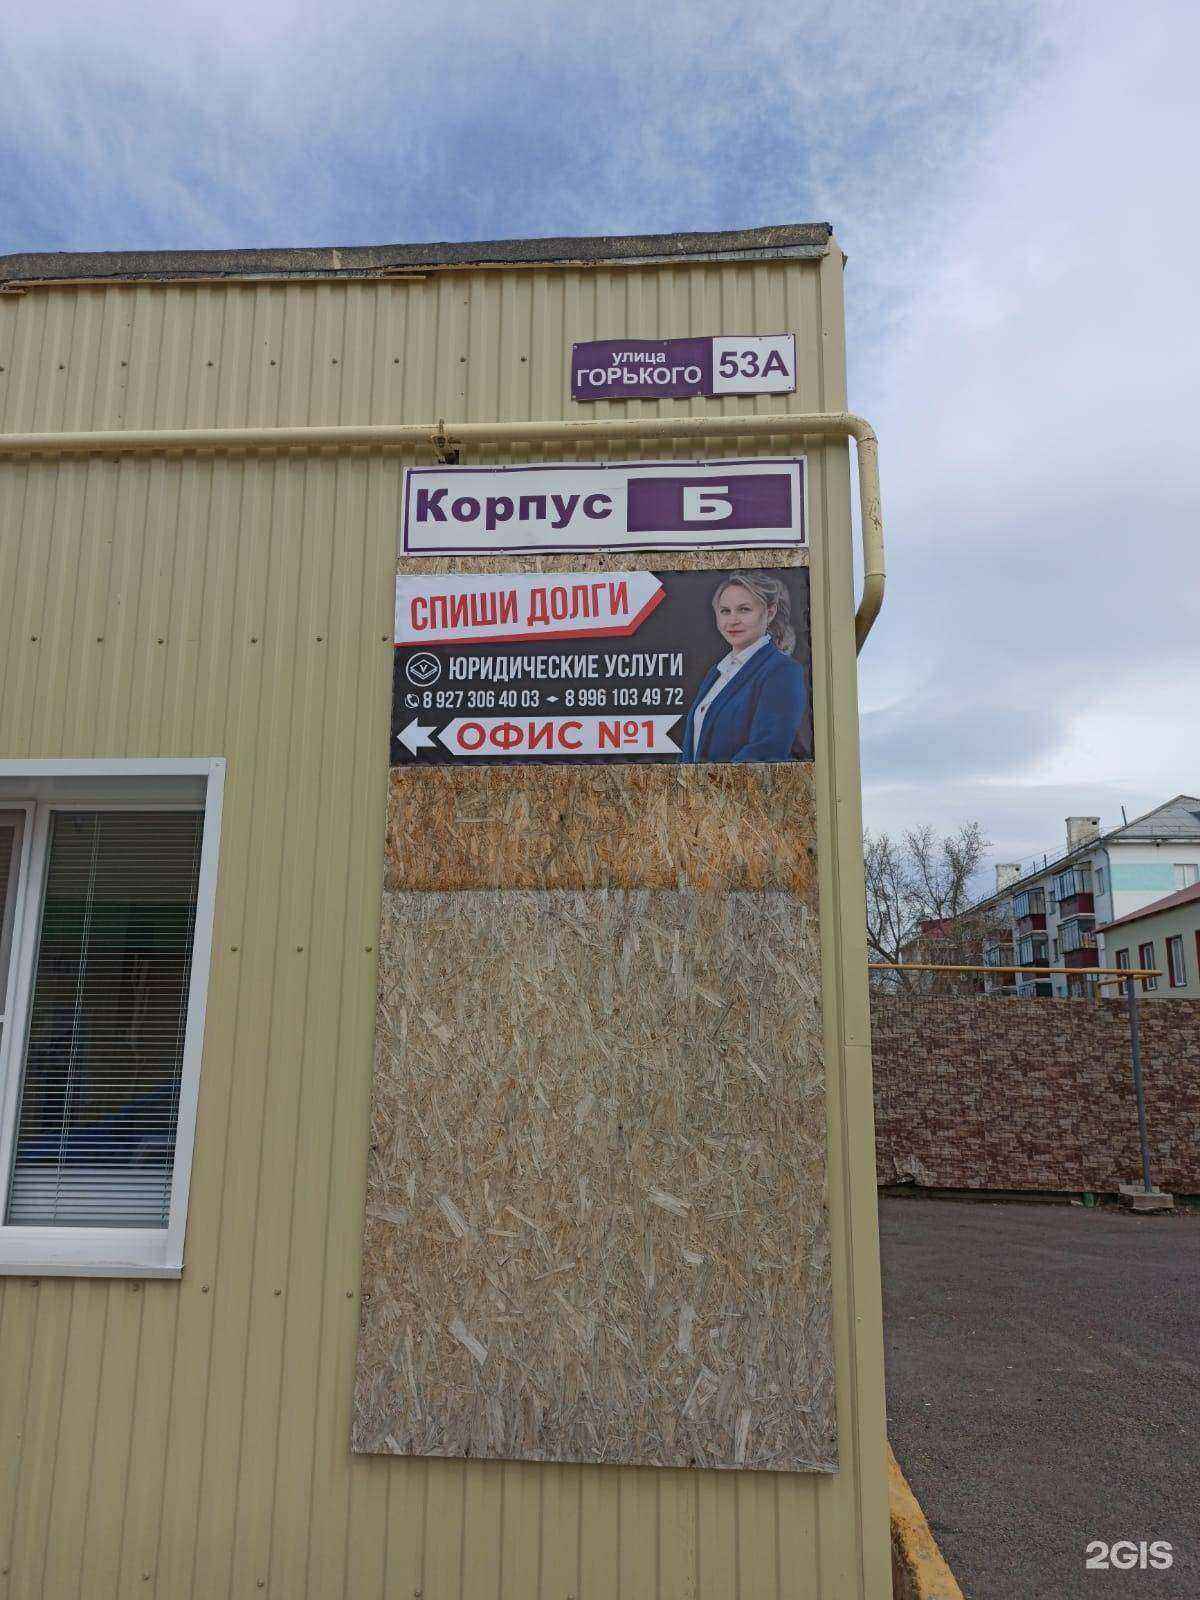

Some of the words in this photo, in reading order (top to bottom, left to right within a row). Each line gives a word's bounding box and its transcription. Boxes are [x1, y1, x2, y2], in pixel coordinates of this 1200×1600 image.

[612, 352, 666, 366] улица
[719, 350, 789, 379] 53А
[577, 366, 702, 387] ГОРЬКОГО
[416, 488, 613, 531] Корпус
[683, 485, 734, 522] Б
[410, 590, 518, 631] СПИШИ
[526, 581, 629, 627] ДОЛГИ
[448, 655, 599, 682] ЮРИДИЧЕСКИЕ
[604, 653, 683, 678] УСЛУГИ
[423, 691, 433, 709] 8
[436, 690, 464, 708] 927
[467, 690, 495, 708] 306
[498, 690, 517, 708] 40
[521, 689, 540, 708] 03
[565, 689, 575, 707] 8
[578, 688, 606, 707] 996
[612, 688, 638, 706] 103
[641, 687, 661, 706] 49
[665, 687, 684, 705] 72
[456, 721, 584, 750] ОФИС
